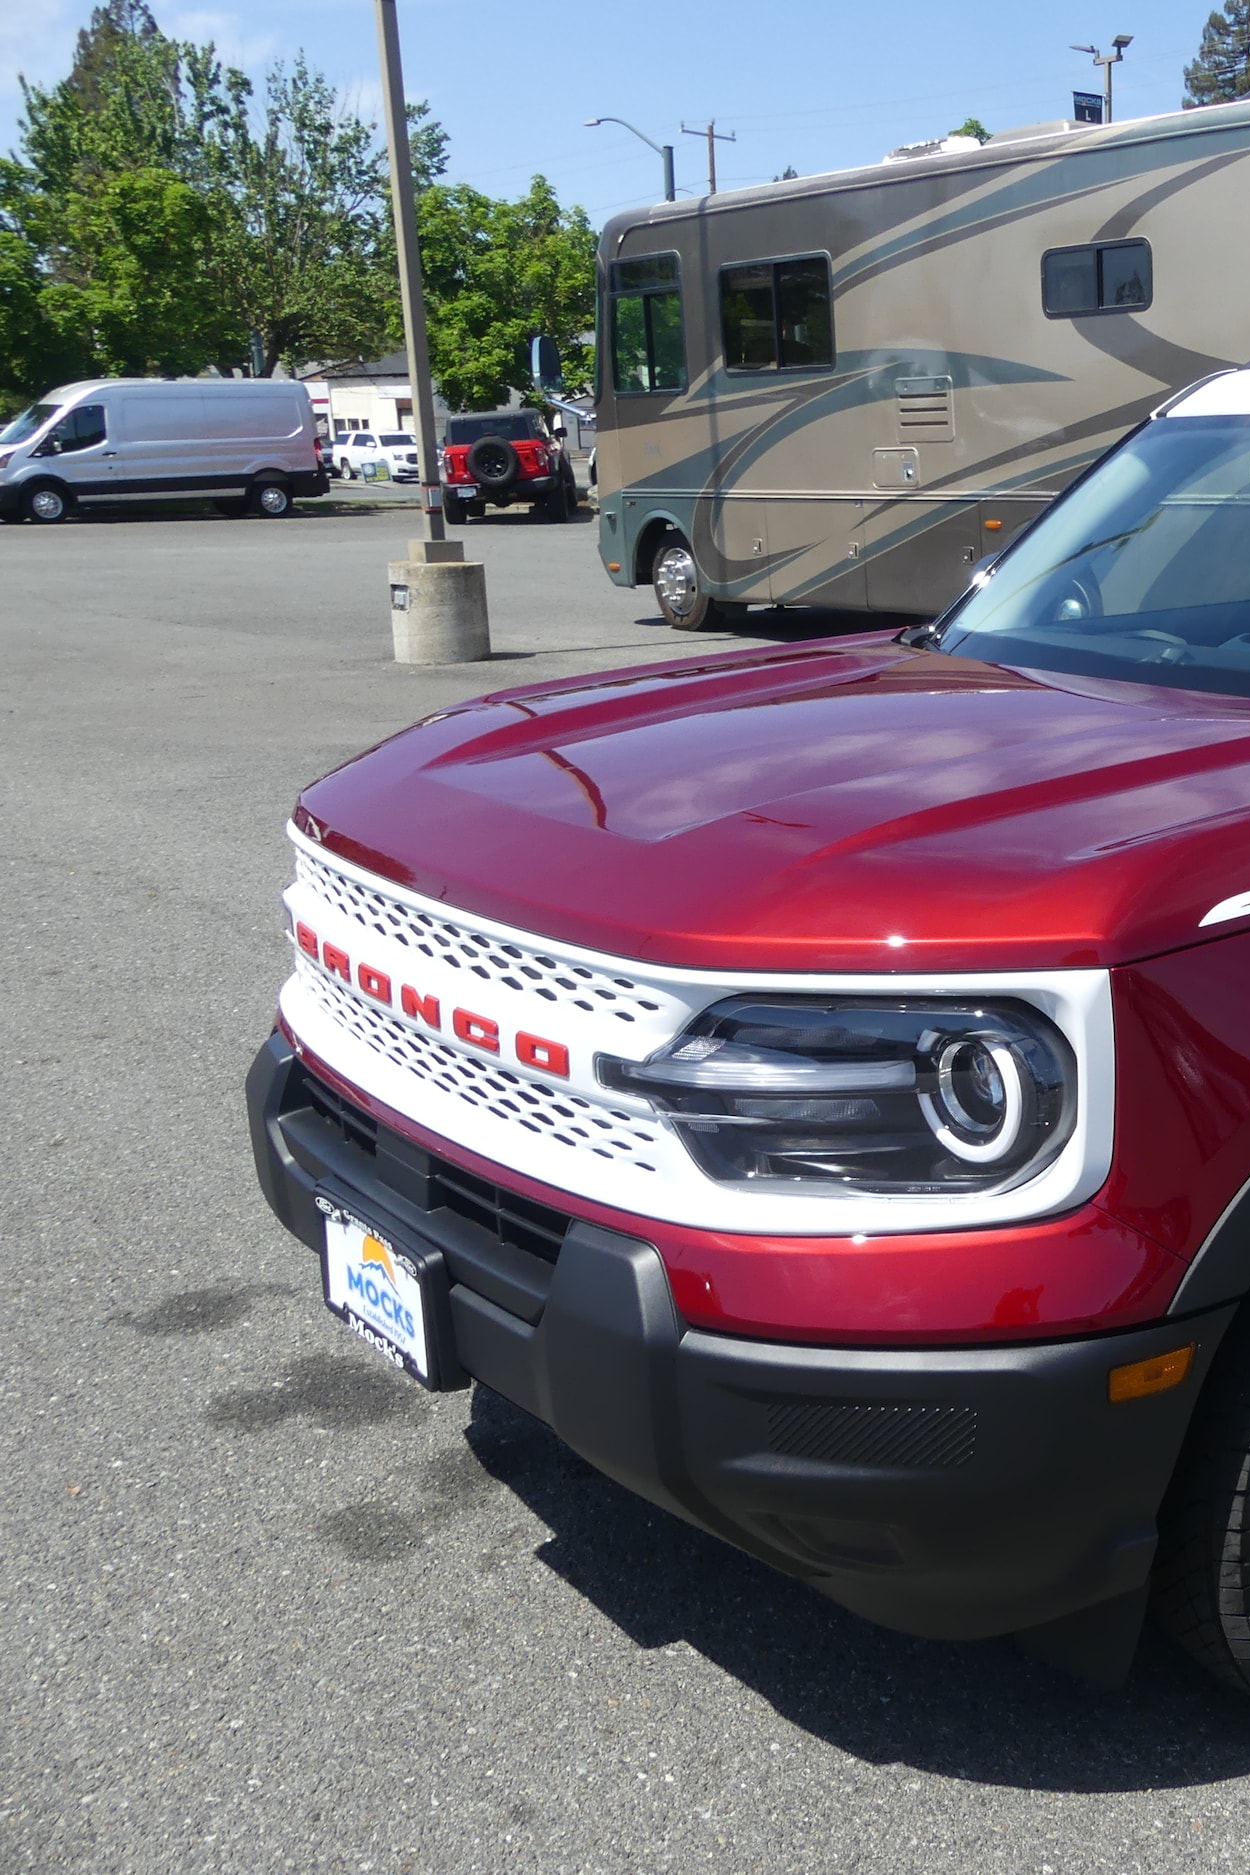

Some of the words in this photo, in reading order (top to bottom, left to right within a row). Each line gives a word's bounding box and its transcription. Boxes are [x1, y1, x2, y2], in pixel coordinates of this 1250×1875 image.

[296, 919, 571, 1078] BRONCO
[346, 1263, 415, 1339] MOCKS
[348, 1311, 404, 1369] Mock's
